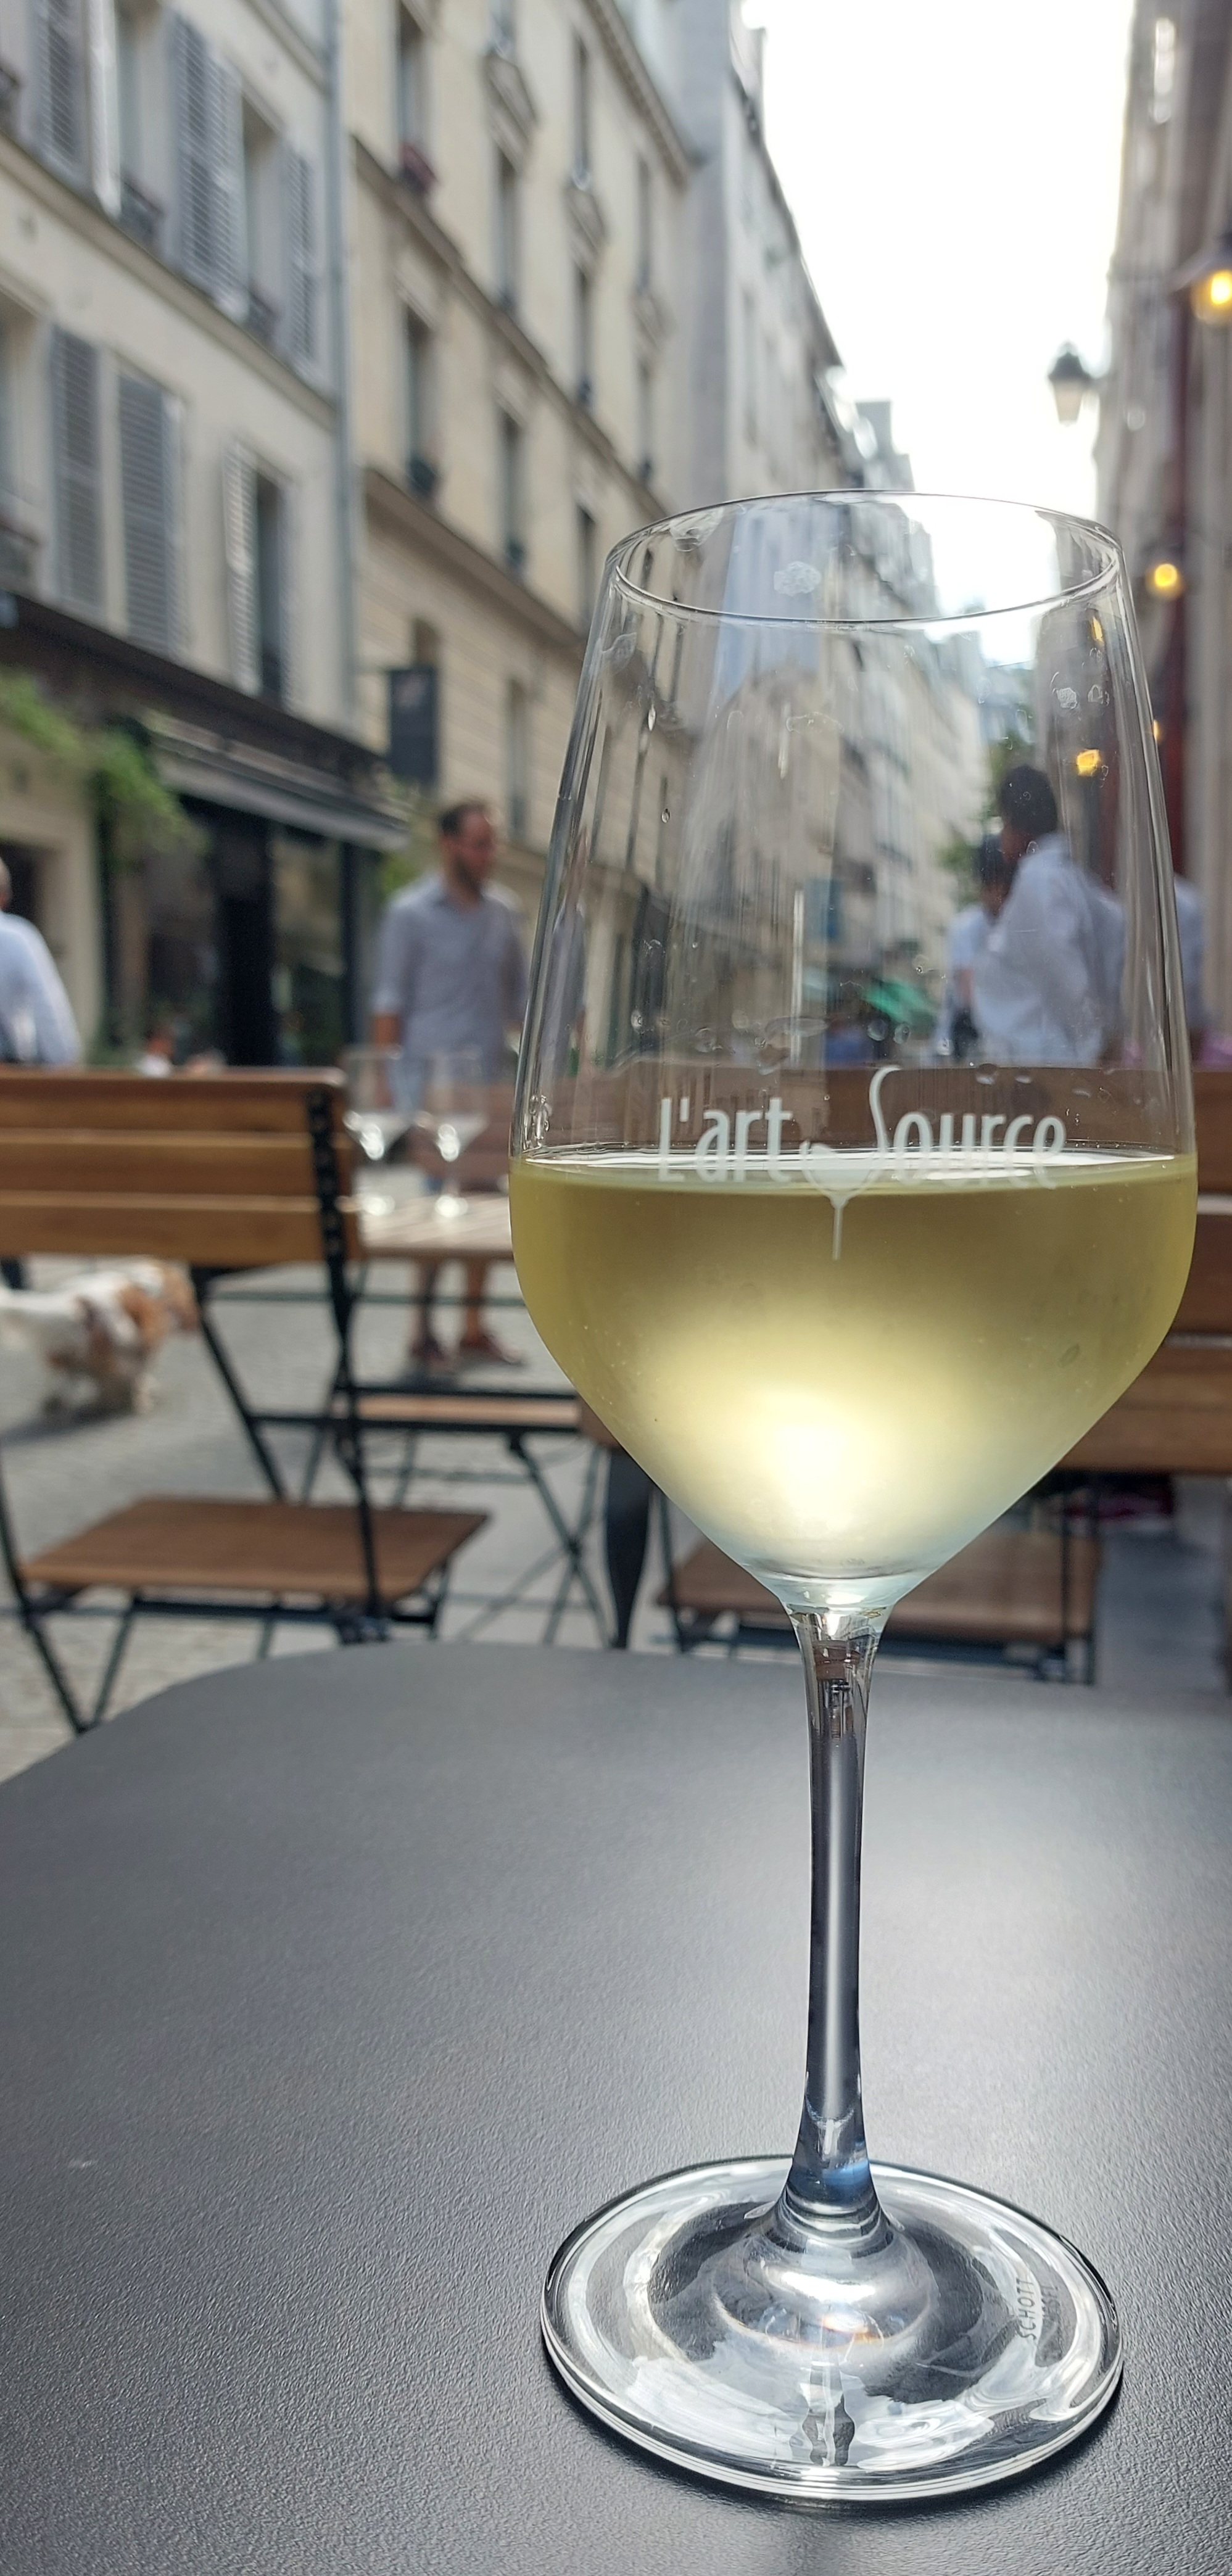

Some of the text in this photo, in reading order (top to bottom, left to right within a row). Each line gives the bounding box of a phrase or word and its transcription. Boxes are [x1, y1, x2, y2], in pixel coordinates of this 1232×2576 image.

[658, 1065, 1066, 1200] L'art Source
[1015, 2277, 1037, 2341] SCHOTT
